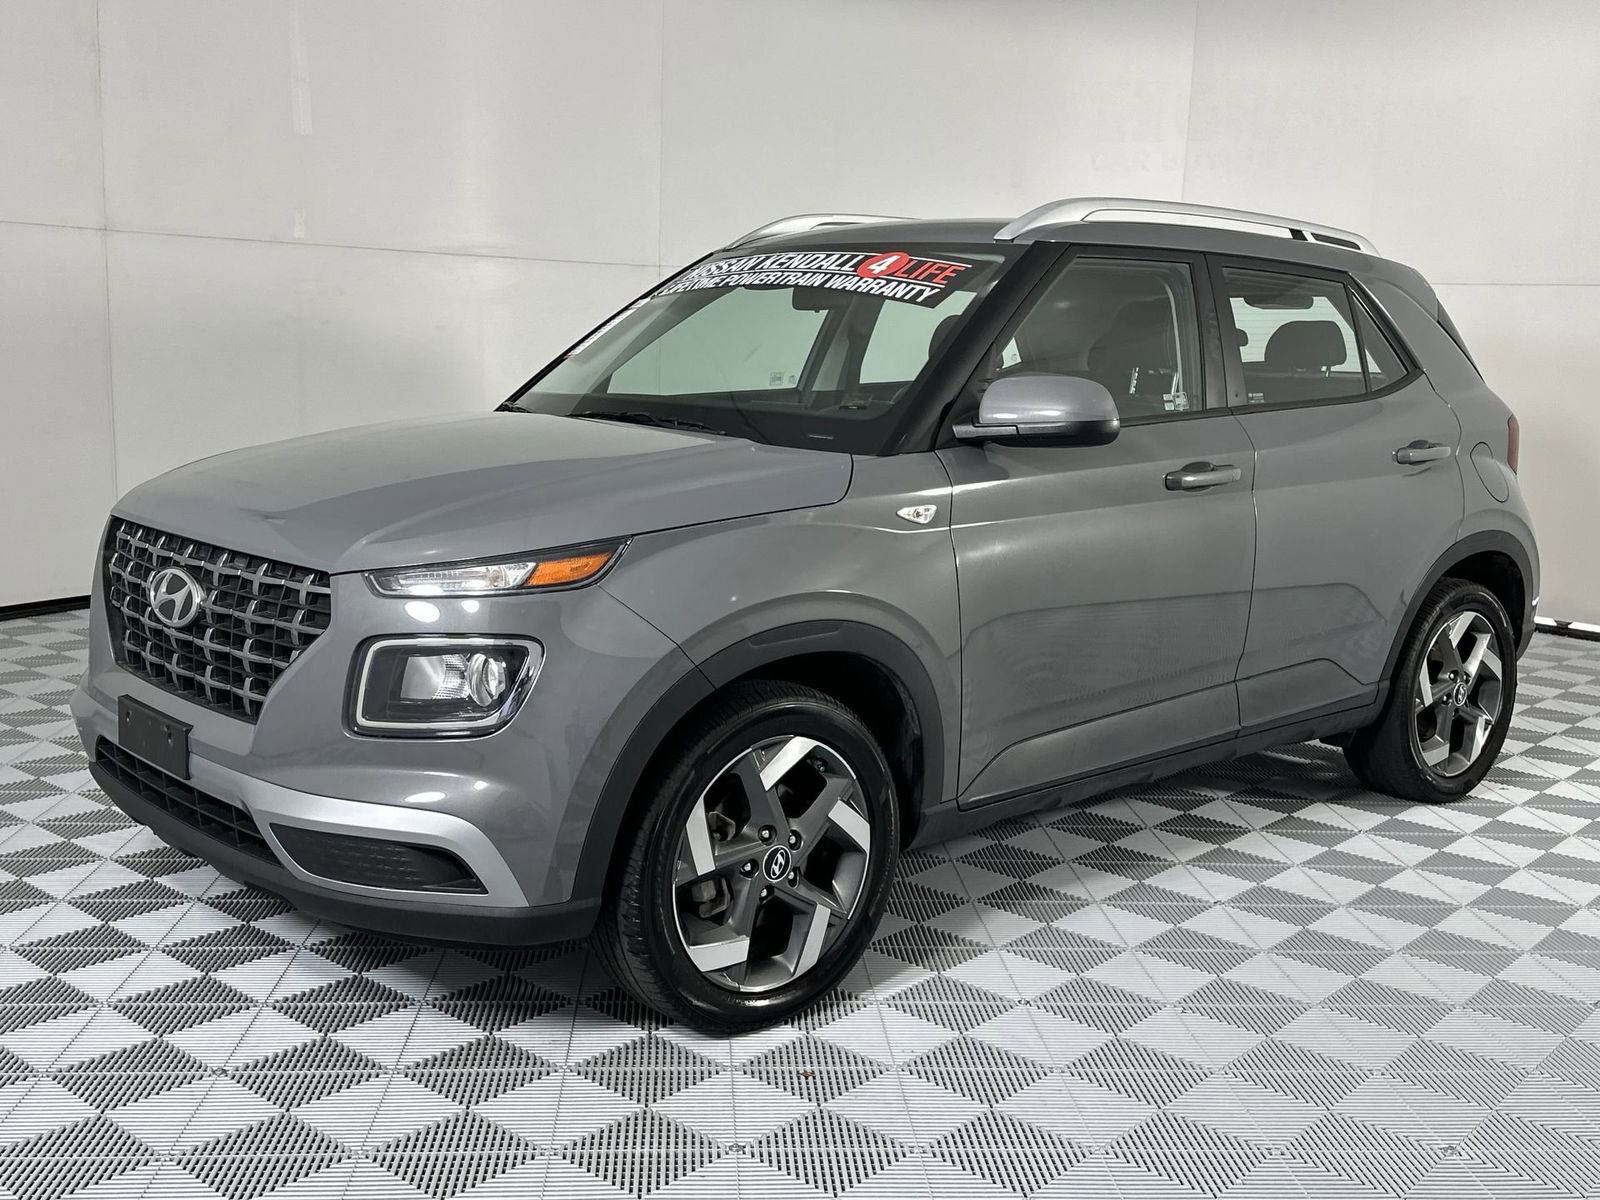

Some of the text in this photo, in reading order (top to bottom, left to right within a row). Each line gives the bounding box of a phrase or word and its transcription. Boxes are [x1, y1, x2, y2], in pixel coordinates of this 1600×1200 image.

[754, 253, 865, 271] KENDALL
[868, 255, 901, 274] 4
[893, 259, 966, 285] LIFE
[718, 271, 827, 288] POWERTRAIN
[823, 273, 941, 302] WARRANTY
